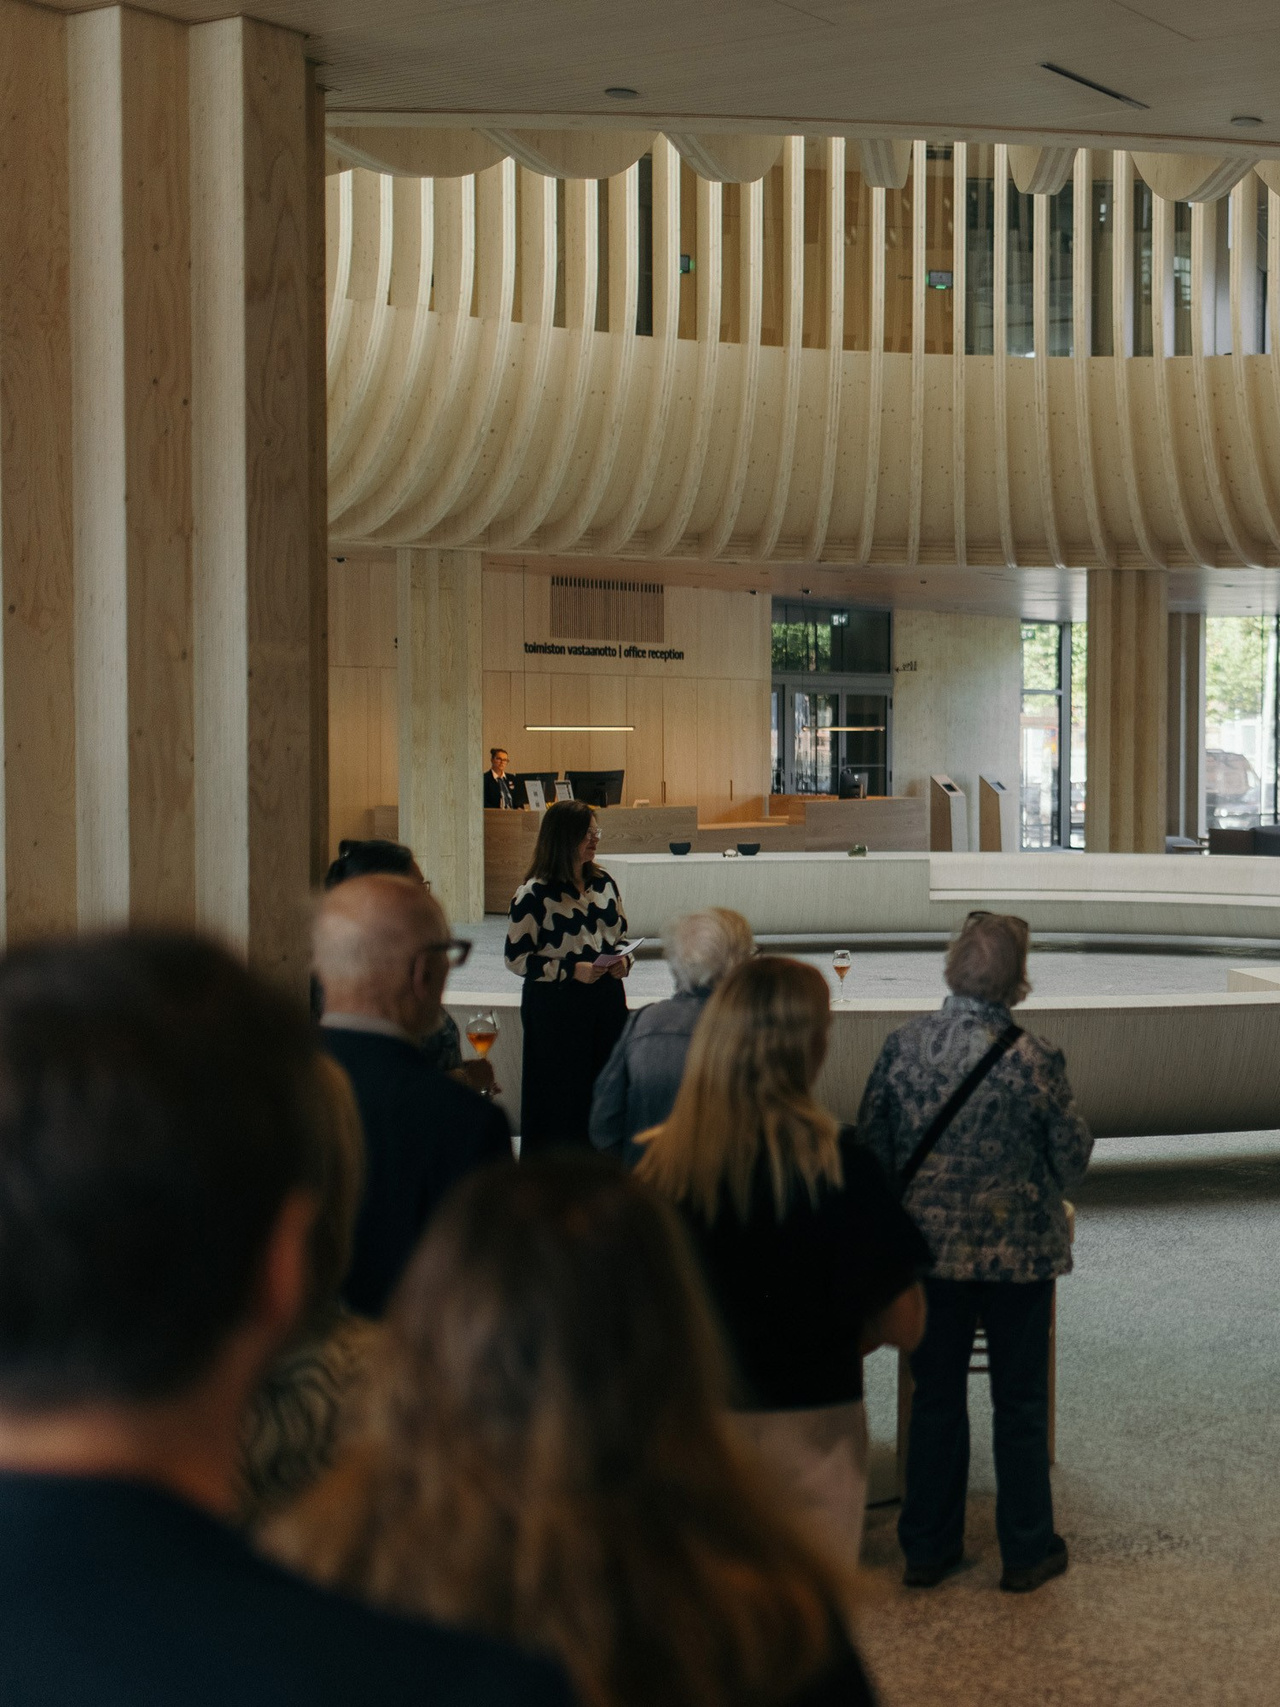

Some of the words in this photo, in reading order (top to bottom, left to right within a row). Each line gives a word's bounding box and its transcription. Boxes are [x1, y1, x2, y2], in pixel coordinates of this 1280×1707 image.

[524, 642, 565, 655] toimiston
[567, 645, 617, 657] vastaanotto
[624, 645, 647, 658] office
[648, 648, 684, 662] reception
